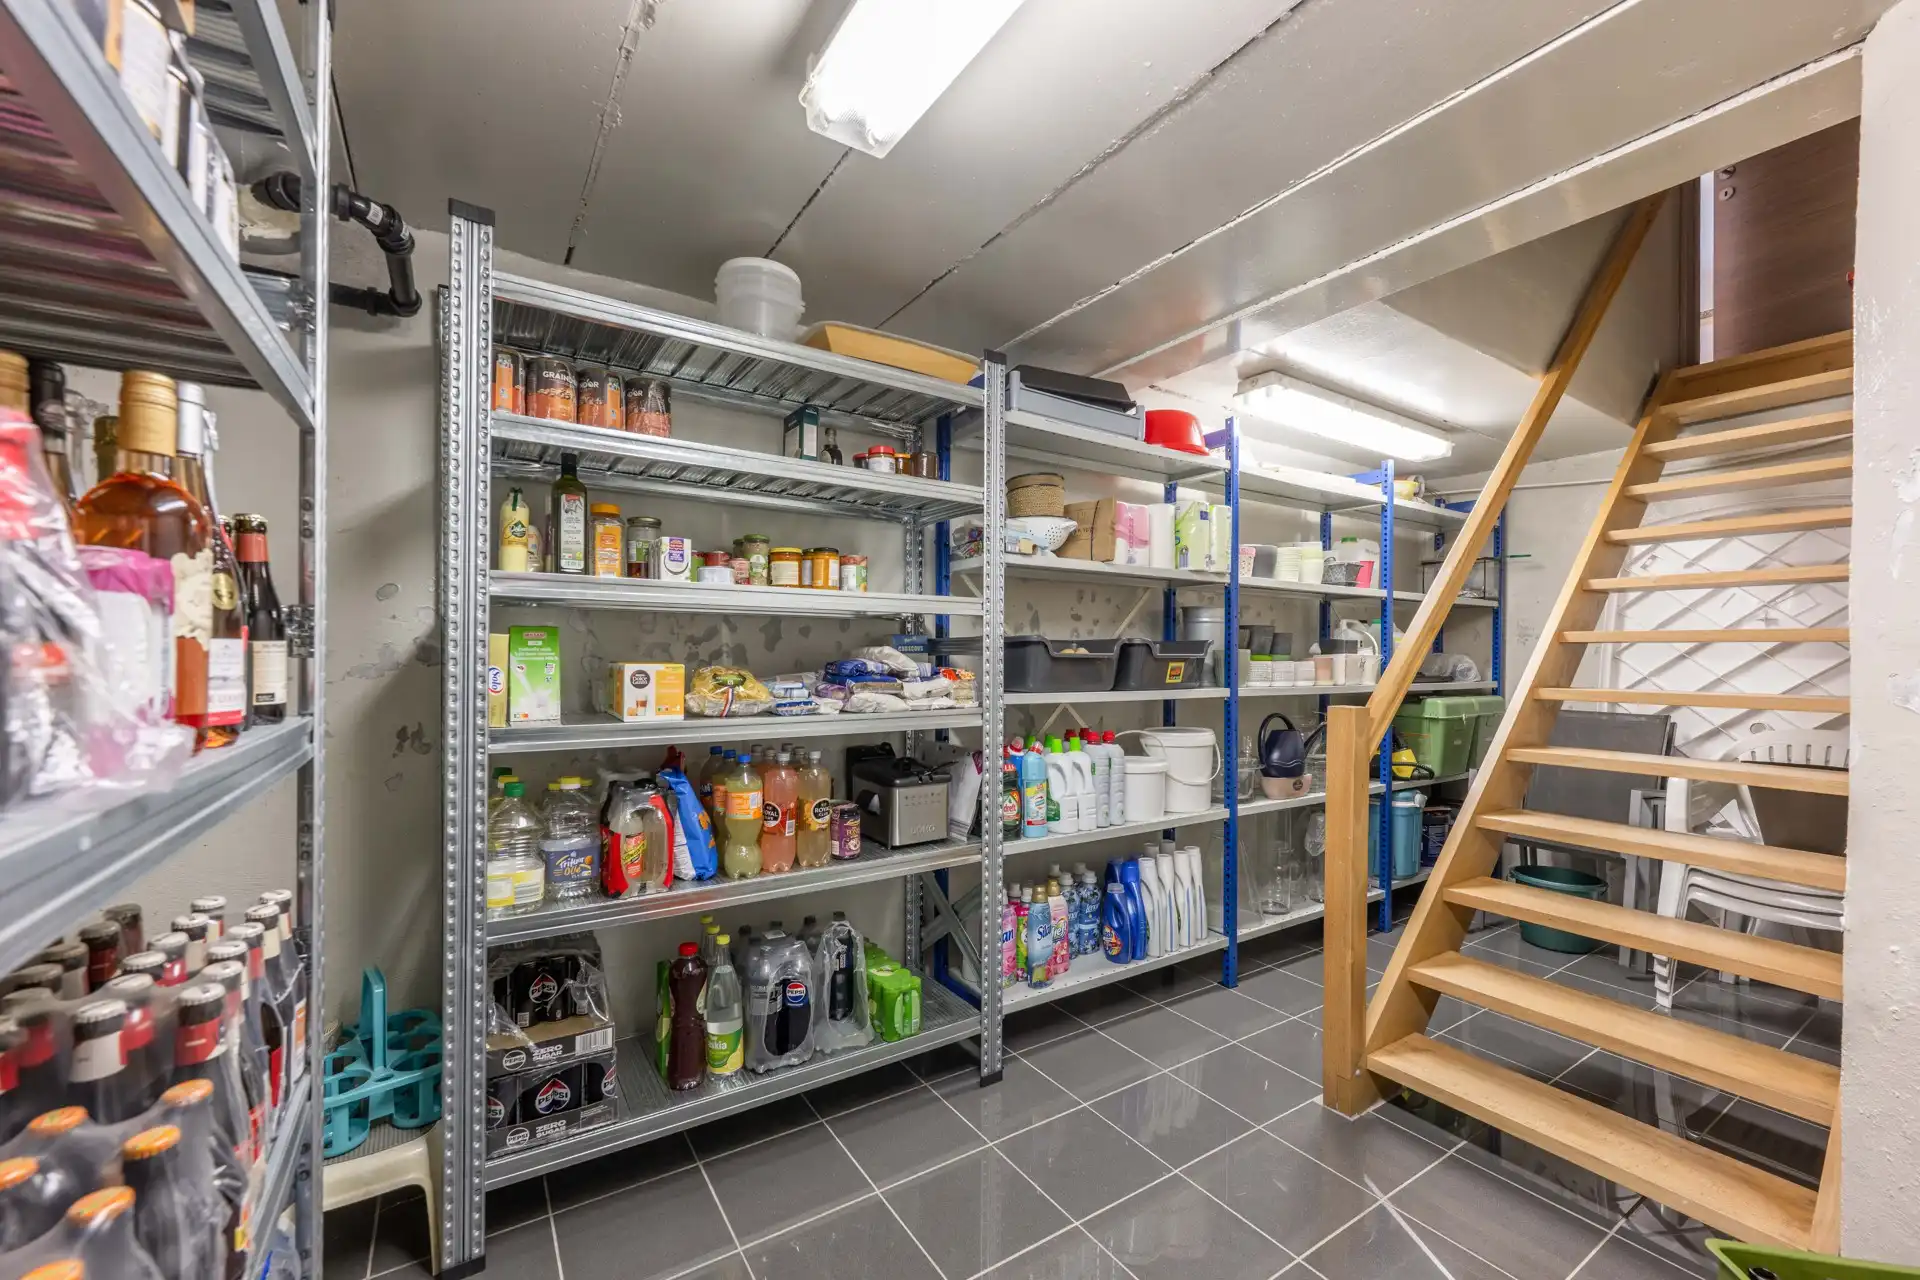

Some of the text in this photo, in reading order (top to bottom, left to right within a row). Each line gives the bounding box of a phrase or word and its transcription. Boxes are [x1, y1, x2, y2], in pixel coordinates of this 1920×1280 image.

[491, 669, 502, 691] Solo
[1036, 924, 1052, 942] Sila
[531, 983, 556, 995] PEPSI
[786, 989, 805, 997] PEPSI
[531, 1044, 563, 1056] ZERO
[532, 1050, 563, 1062] SUGAR
[537, 1090, 568, 1105] PEPSI
[535, 1119, 567, 1133] ZERO
[535, 1125, 566, 1138] SUGAR
[507, 1133, 529, 1144] PEPSI
